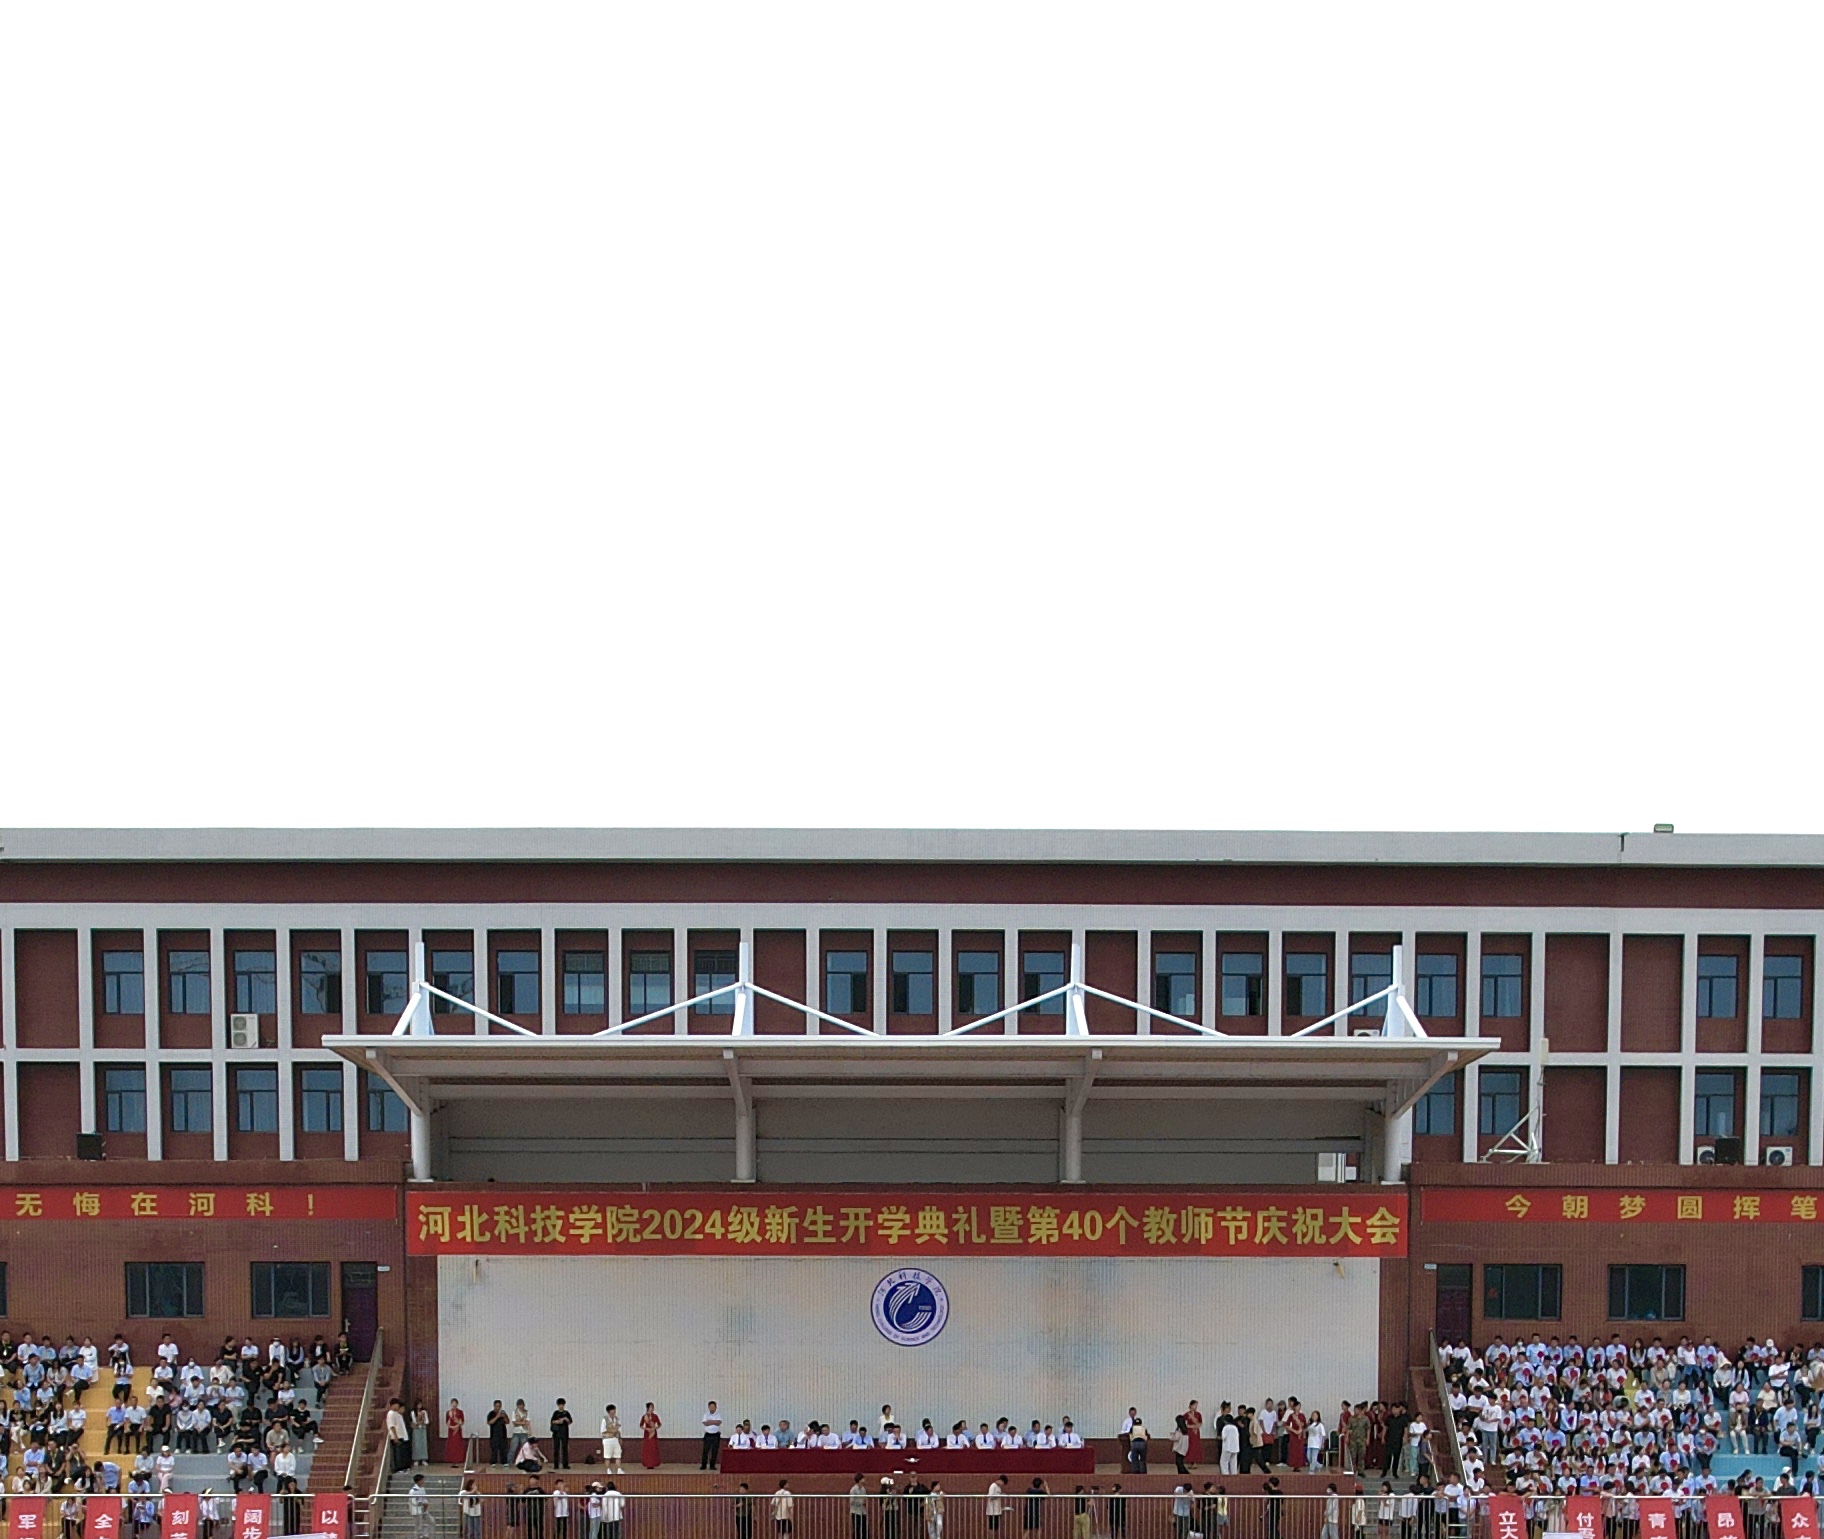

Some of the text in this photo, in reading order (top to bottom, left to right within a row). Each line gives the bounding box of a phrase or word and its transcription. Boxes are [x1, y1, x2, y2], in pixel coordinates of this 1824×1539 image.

[417, 1203, 1401, 1246] 河北科技学院2024级新生开学典礼暨第40个教师节庆祝大会
